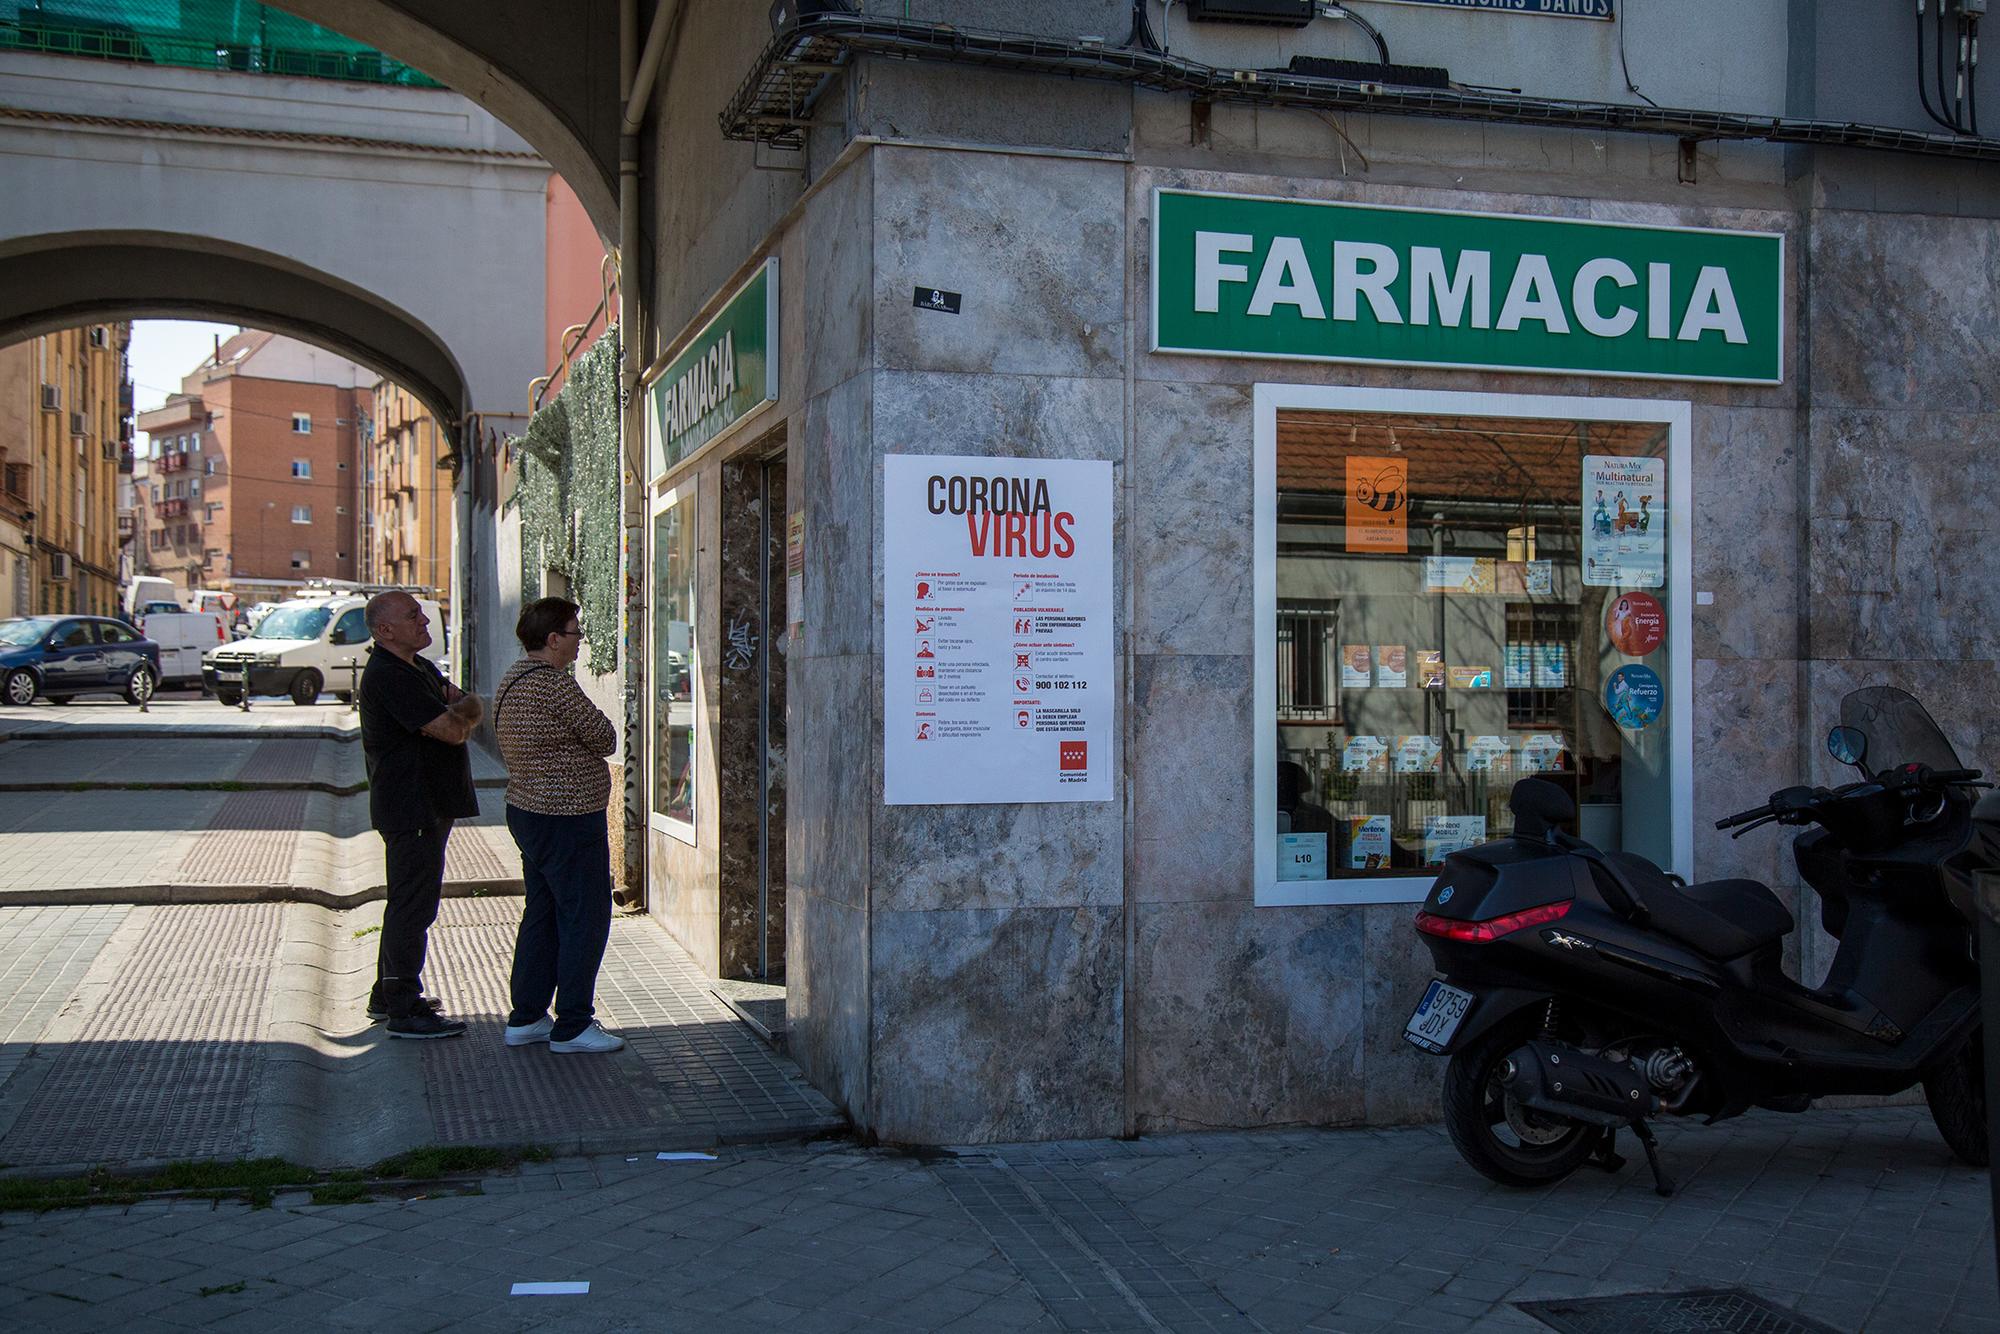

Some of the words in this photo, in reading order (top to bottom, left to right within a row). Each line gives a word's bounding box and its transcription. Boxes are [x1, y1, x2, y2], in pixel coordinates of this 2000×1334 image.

[1194, 230, 1749, 344] FARMACIA
[664, 330, 737, 445] FARMACIA
[1596, 471, 1654, 483] Multinatural
[927, 475, 1052, 517] CORONA
[966, 509, 1076, 559] VIRUS
[1635, 617, 1660, 626] Energía
[1035, 681, 1052, 690] 900
[1054, 681, 1070, 690] 102
[1071, 681, 1087, 690] 112
[1629, 687, 1658, 695] Refuerzo
[1295, 854, 1312, 863] L10
[1422, 1001, 1430, 1010] E
[1432, 988, 1469, 1019] 9759
[1419, 1012, 1450, 1038] JDY
